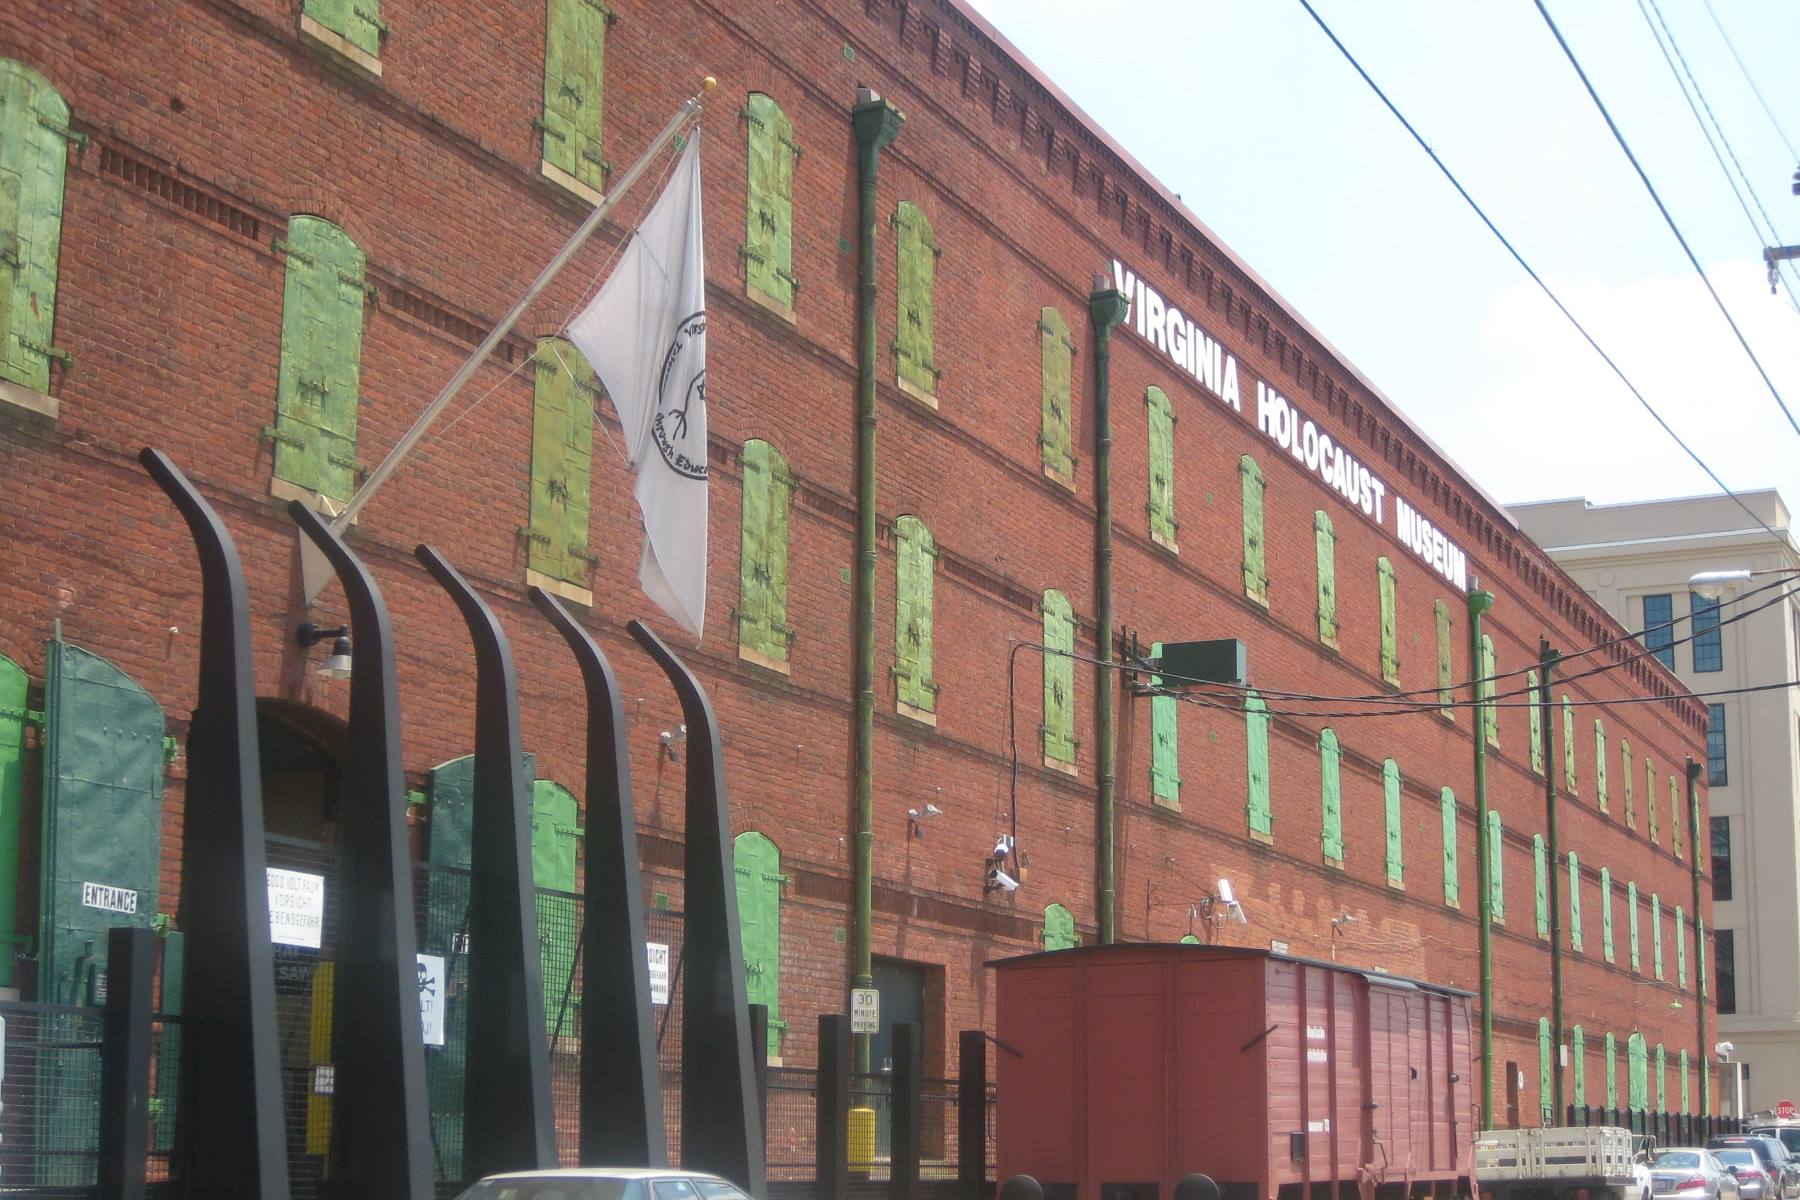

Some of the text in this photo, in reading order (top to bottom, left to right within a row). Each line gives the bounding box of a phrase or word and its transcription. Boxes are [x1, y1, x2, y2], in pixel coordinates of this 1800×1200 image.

[1113, 259, 1467, 592] VIRGINIA HOLOCAUST MUSEUM
[85, 885, 136, 912] ENTRANCE
[858, 994, 872, 1005] 30
[854, 1008, 876, 1018] MINUTE
[1777, 1106, 1795, 1115] STOP
